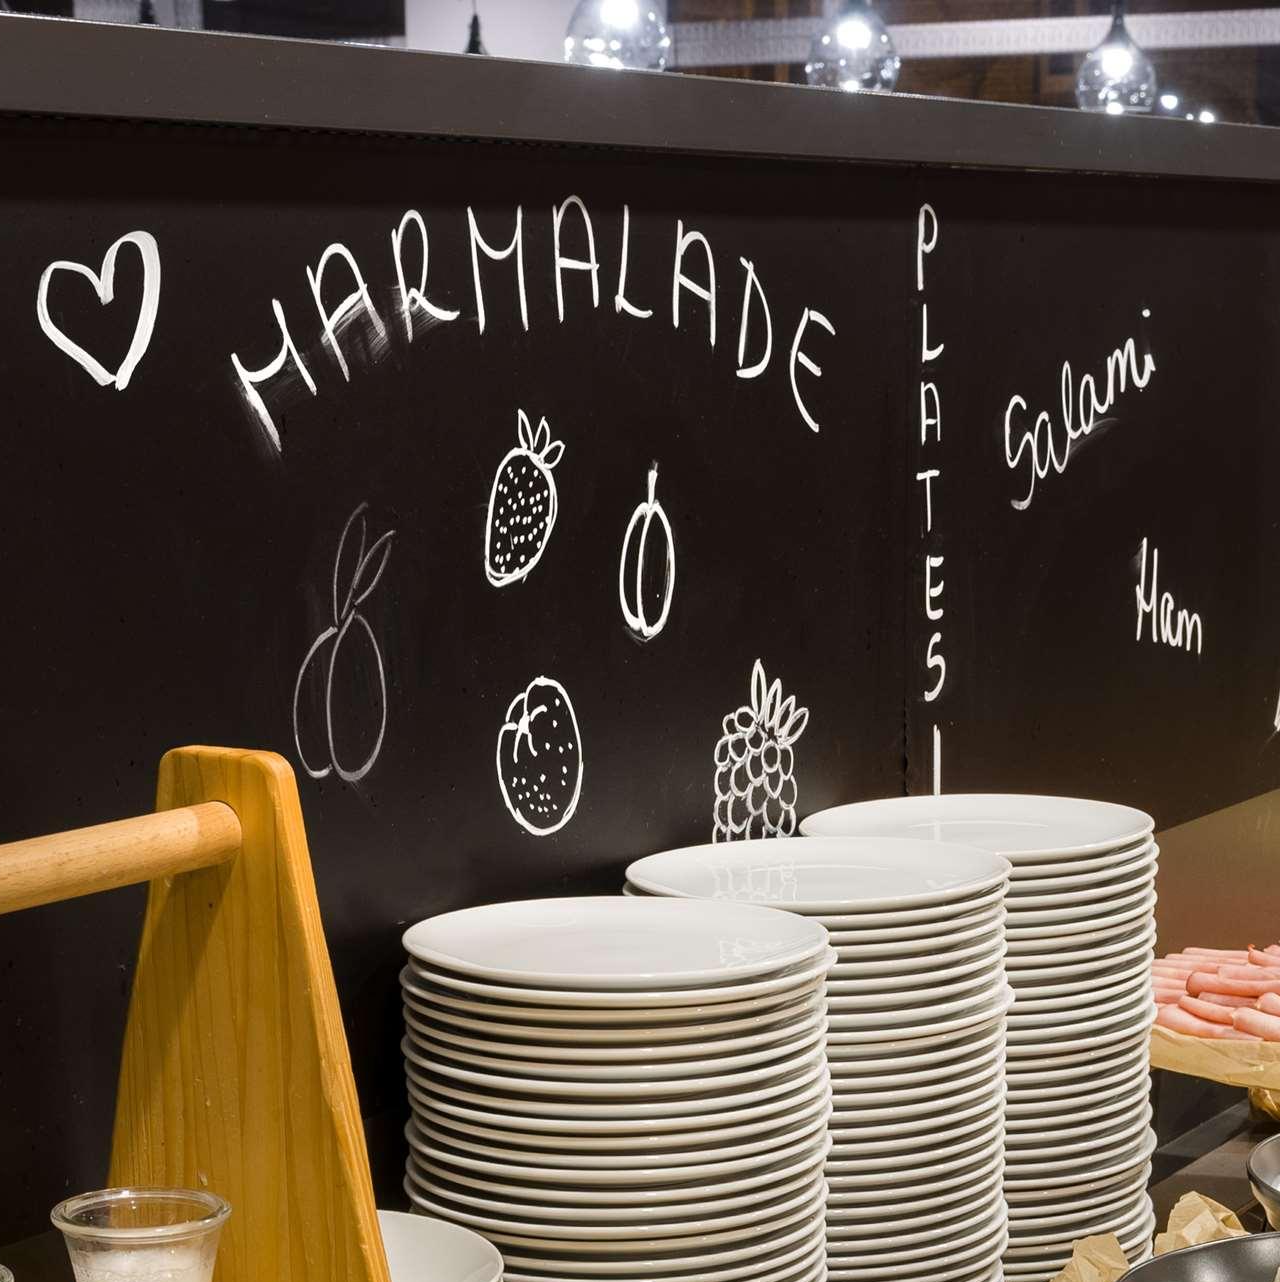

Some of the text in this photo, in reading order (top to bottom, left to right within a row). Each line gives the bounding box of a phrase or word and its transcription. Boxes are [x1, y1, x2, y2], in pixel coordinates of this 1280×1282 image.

[230, 195, 835, 452] MARMALADE
[1004, 308, 1157, 510] Salami
[1136, 537, 1202, 655] Ham
